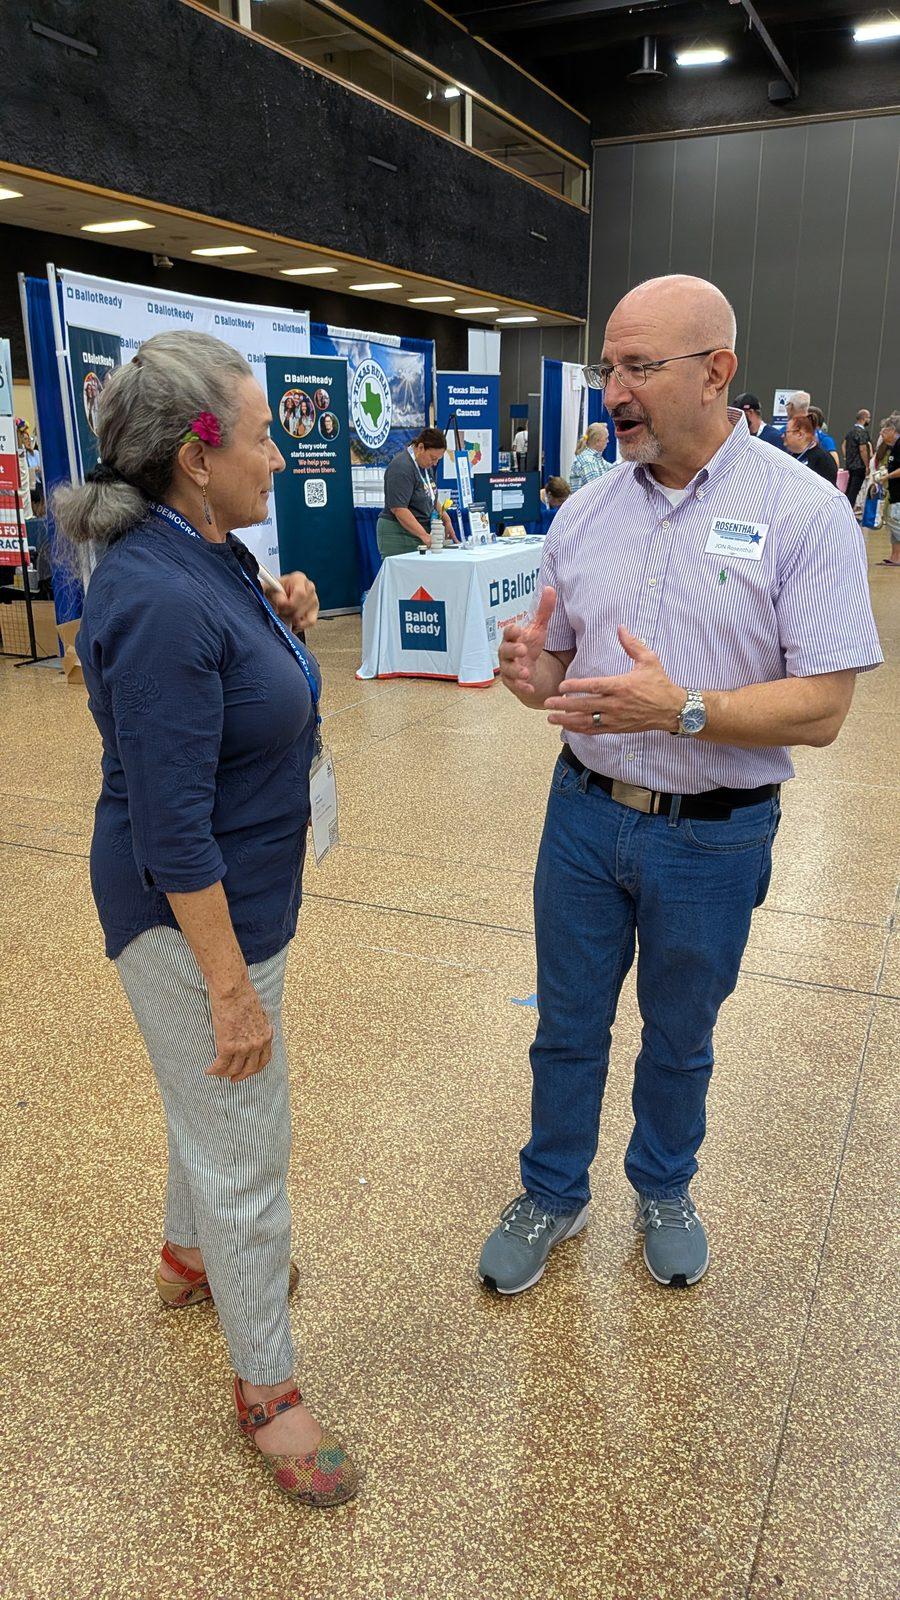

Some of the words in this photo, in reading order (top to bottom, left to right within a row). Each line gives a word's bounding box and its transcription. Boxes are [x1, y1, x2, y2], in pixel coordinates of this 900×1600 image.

[75, 289, 122, 309] BallotReady
[154, 304, 194, 322] BallotReady
[220, 315, 255, 330] BallotReady
[278, 323, 307, 335] BallotReady
[88, 352, 115, 368] BallotReady
[292, 375, 333, 386] BallotReady
[353, 365, 371, 396] TEXAS
[371, 364, 389, 399] RURAL
[448, 386, 468, 394] Texas
[469, 386, 489, 394] Rural
[449, 397, 487, 405] Democratic
[355, 417, 389, 446] DEMOCRATS
[298, 442, 313, 450] Every
[307, 459, 319, 467] help
[715, 520, 755, 535] ROSENTHAL
[404, 611, 439, 623] Ballot
[405, 622, 441, 637] Ready
